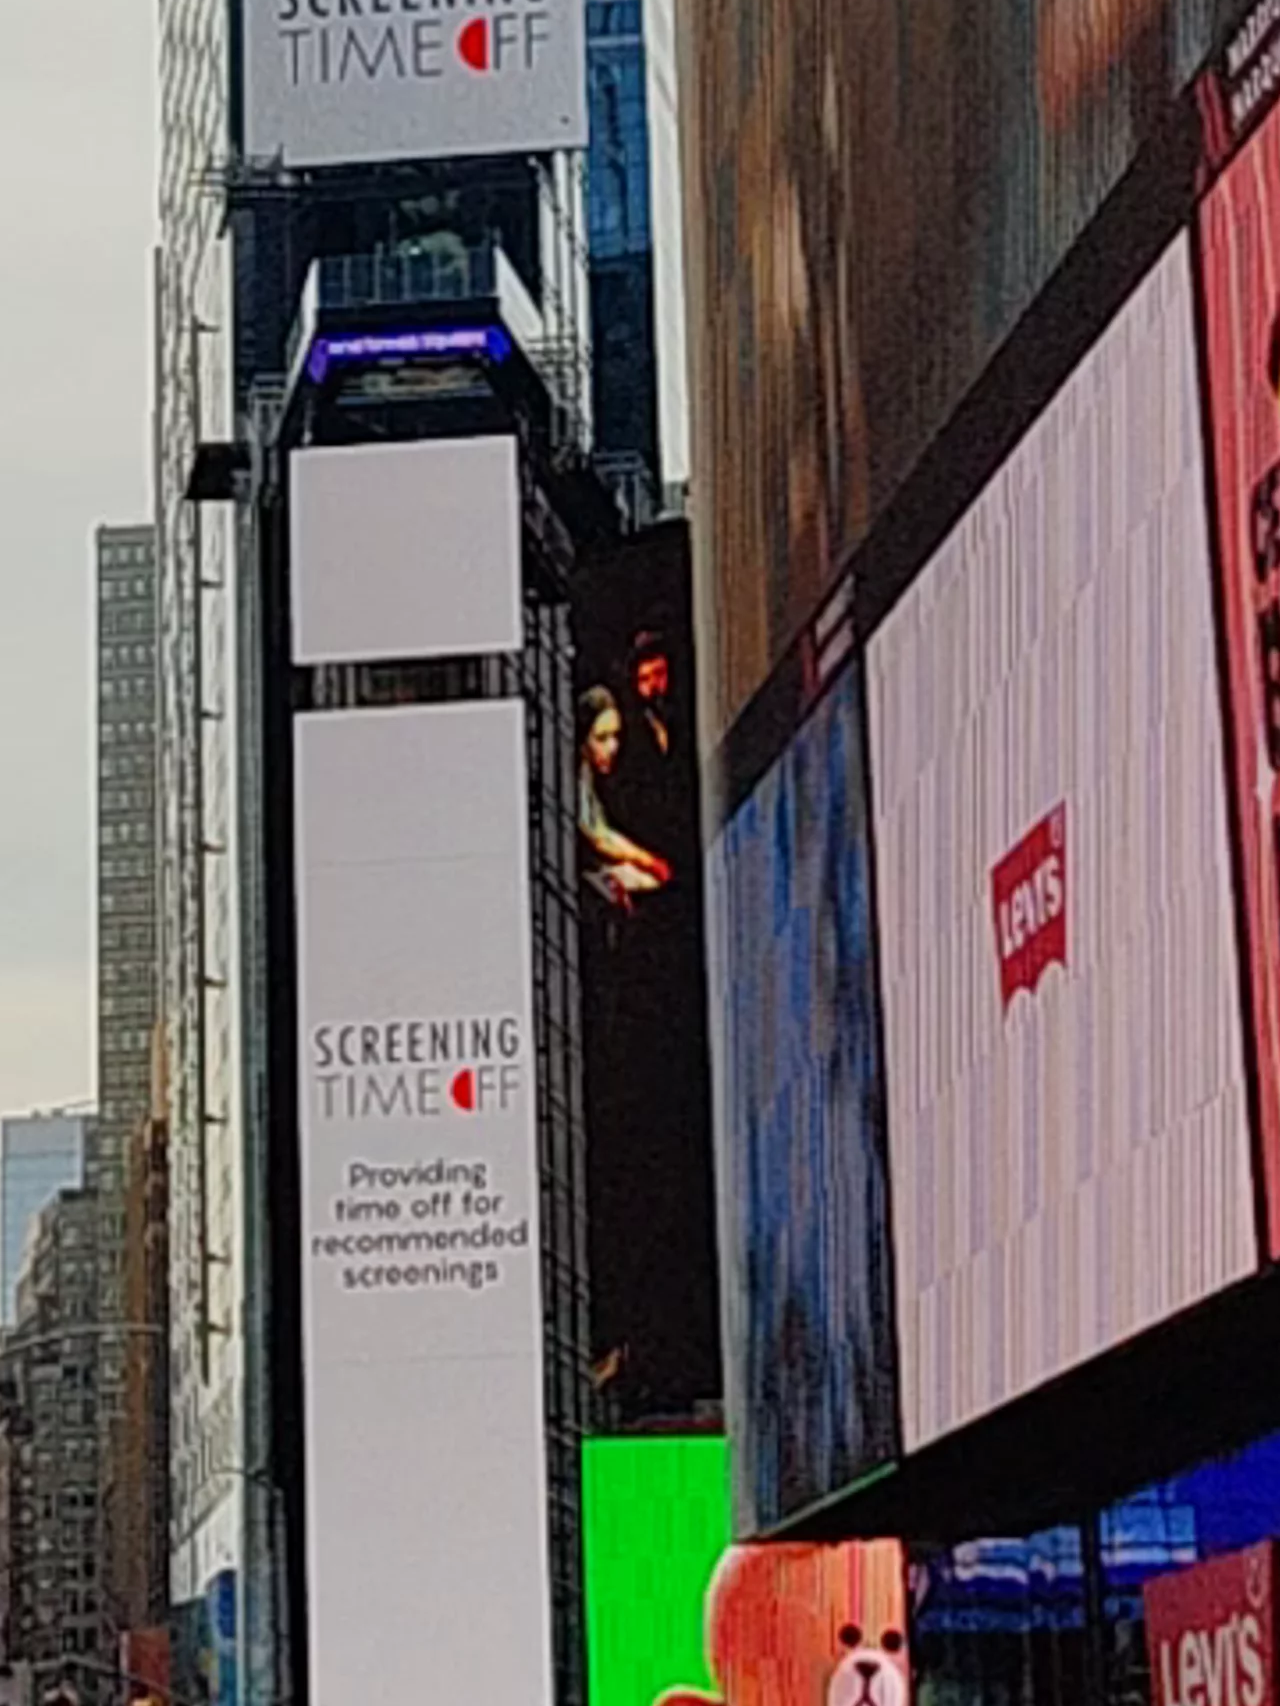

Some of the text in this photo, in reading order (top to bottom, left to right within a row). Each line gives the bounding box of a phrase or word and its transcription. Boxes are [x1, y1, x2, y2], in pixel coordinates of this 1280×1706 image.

[280, 18, 444, 85] TIME
[314, 1017, 521, 1068] SCREENING
[316, 1068, 441, 1120] TIME
[348, 1158, 488, 1190] Providing
[335, 1192, 503, 1222] time off for
[311, 1221, 530, 1256] recommended
[342, 1258, 499, 1289] screenings
